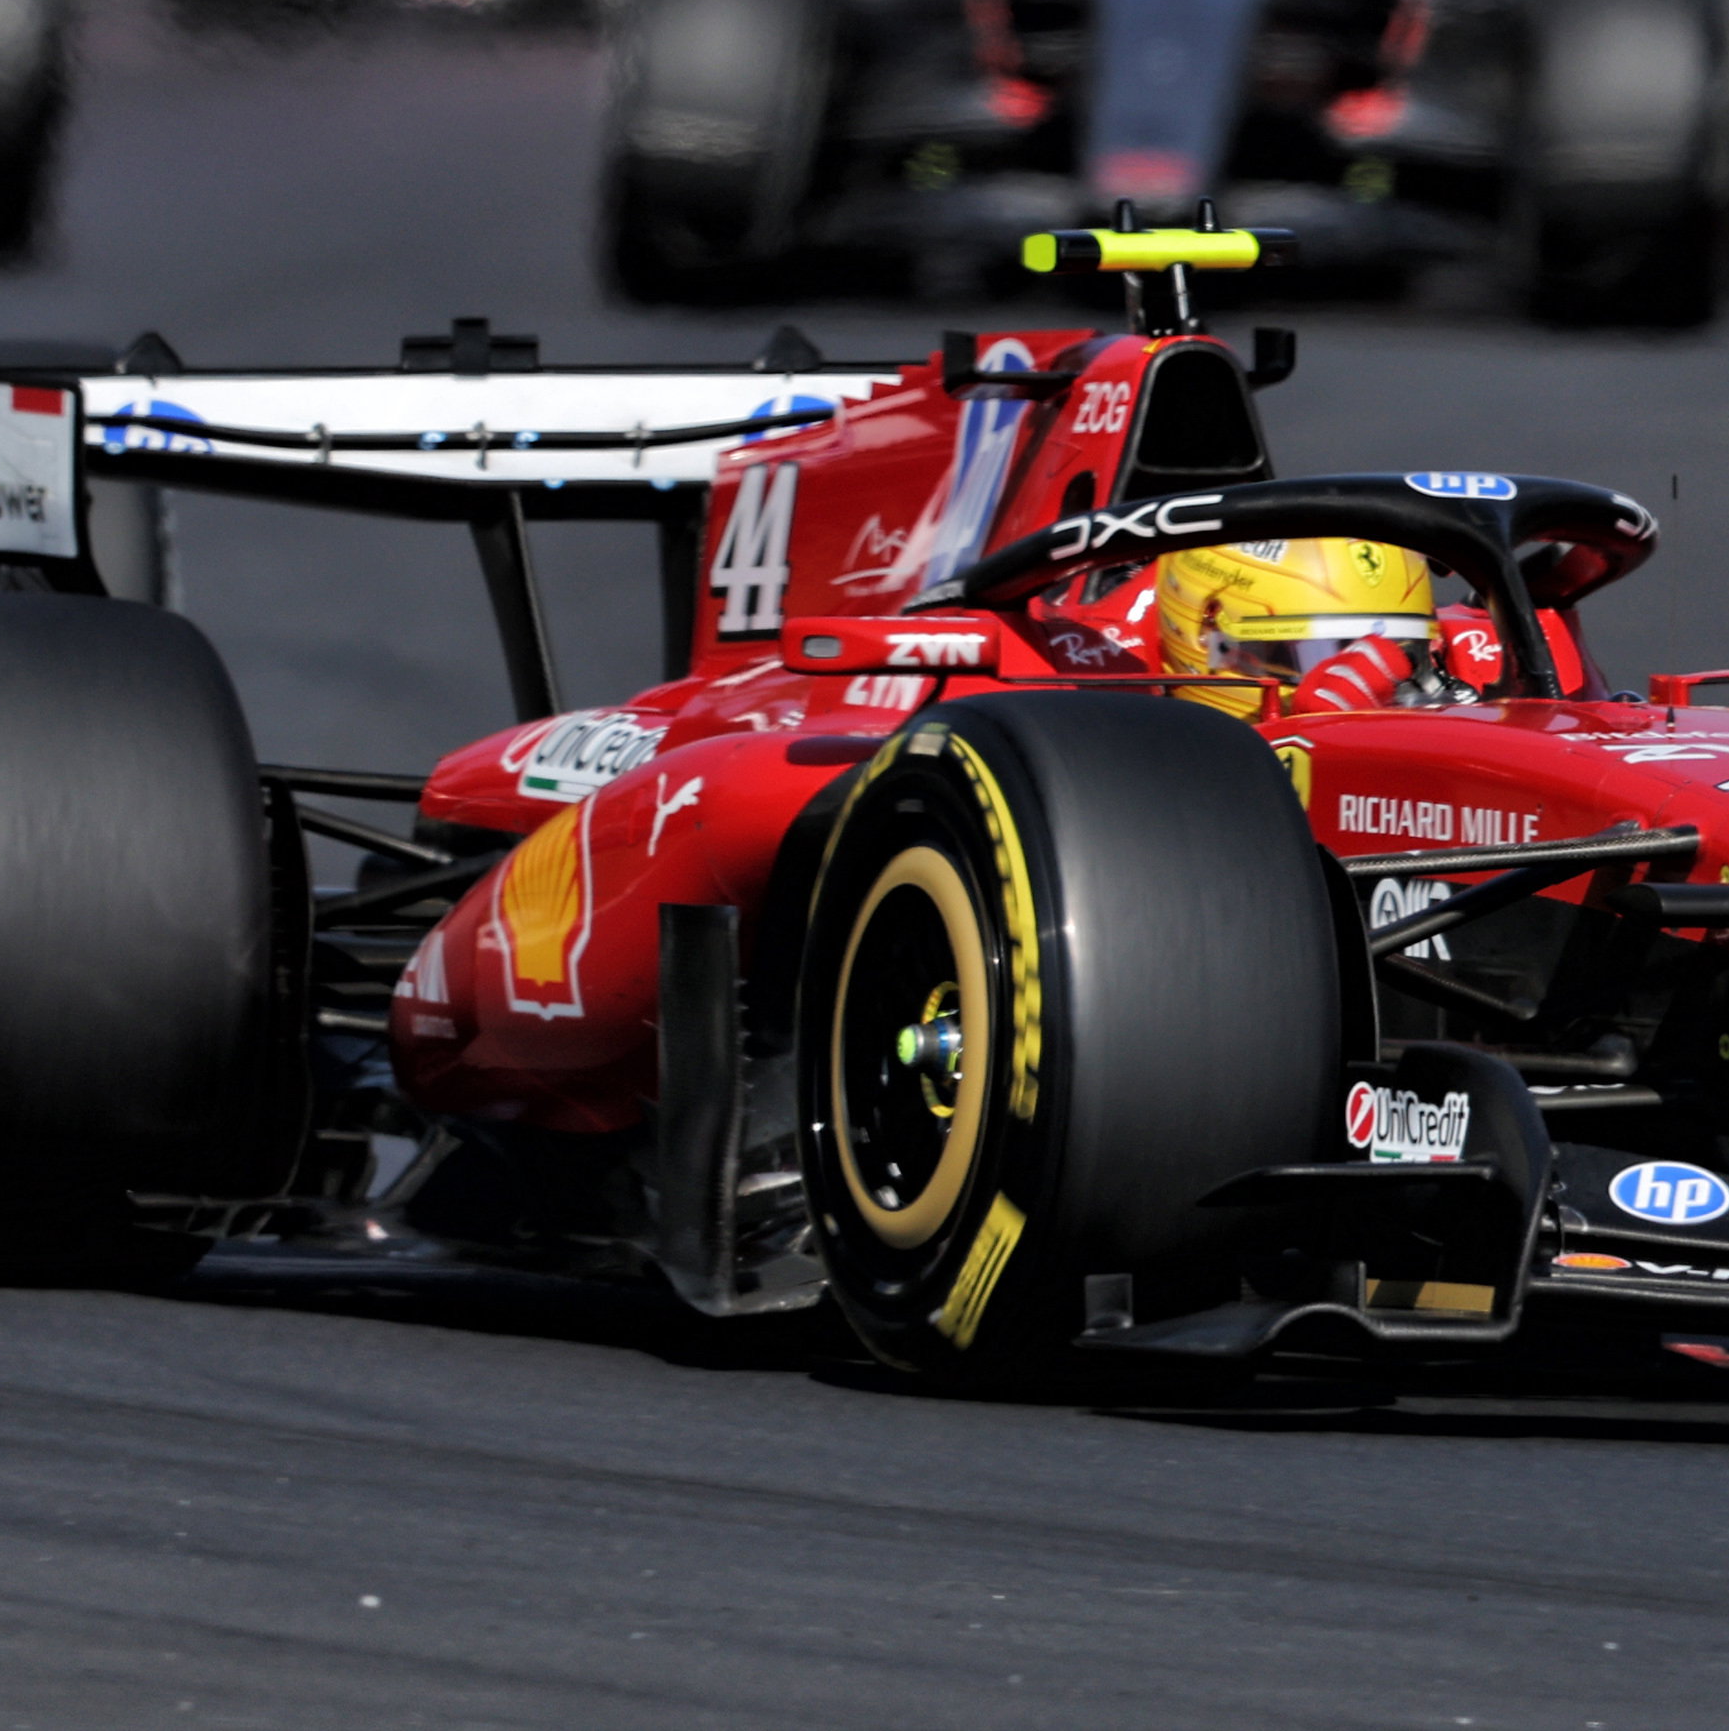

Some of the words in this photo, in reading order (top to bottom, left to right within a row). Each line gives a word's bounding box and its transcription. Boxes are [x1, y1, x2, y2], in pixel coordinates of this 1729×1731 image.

[1072, 380, 1130, 434] ZCG
[710, 460, 800, 638] 44
[1051, 494, 1223, 560] DXC
[885, 632, 988, 667] ZYN
[1339, 794, 1453, 841] RICHARD
[1461, 806, 1539, 846] MILLE
[1377, 1092, 1465, 1147] UniCredit
[1633, 1166, 1710, 1221] hp
